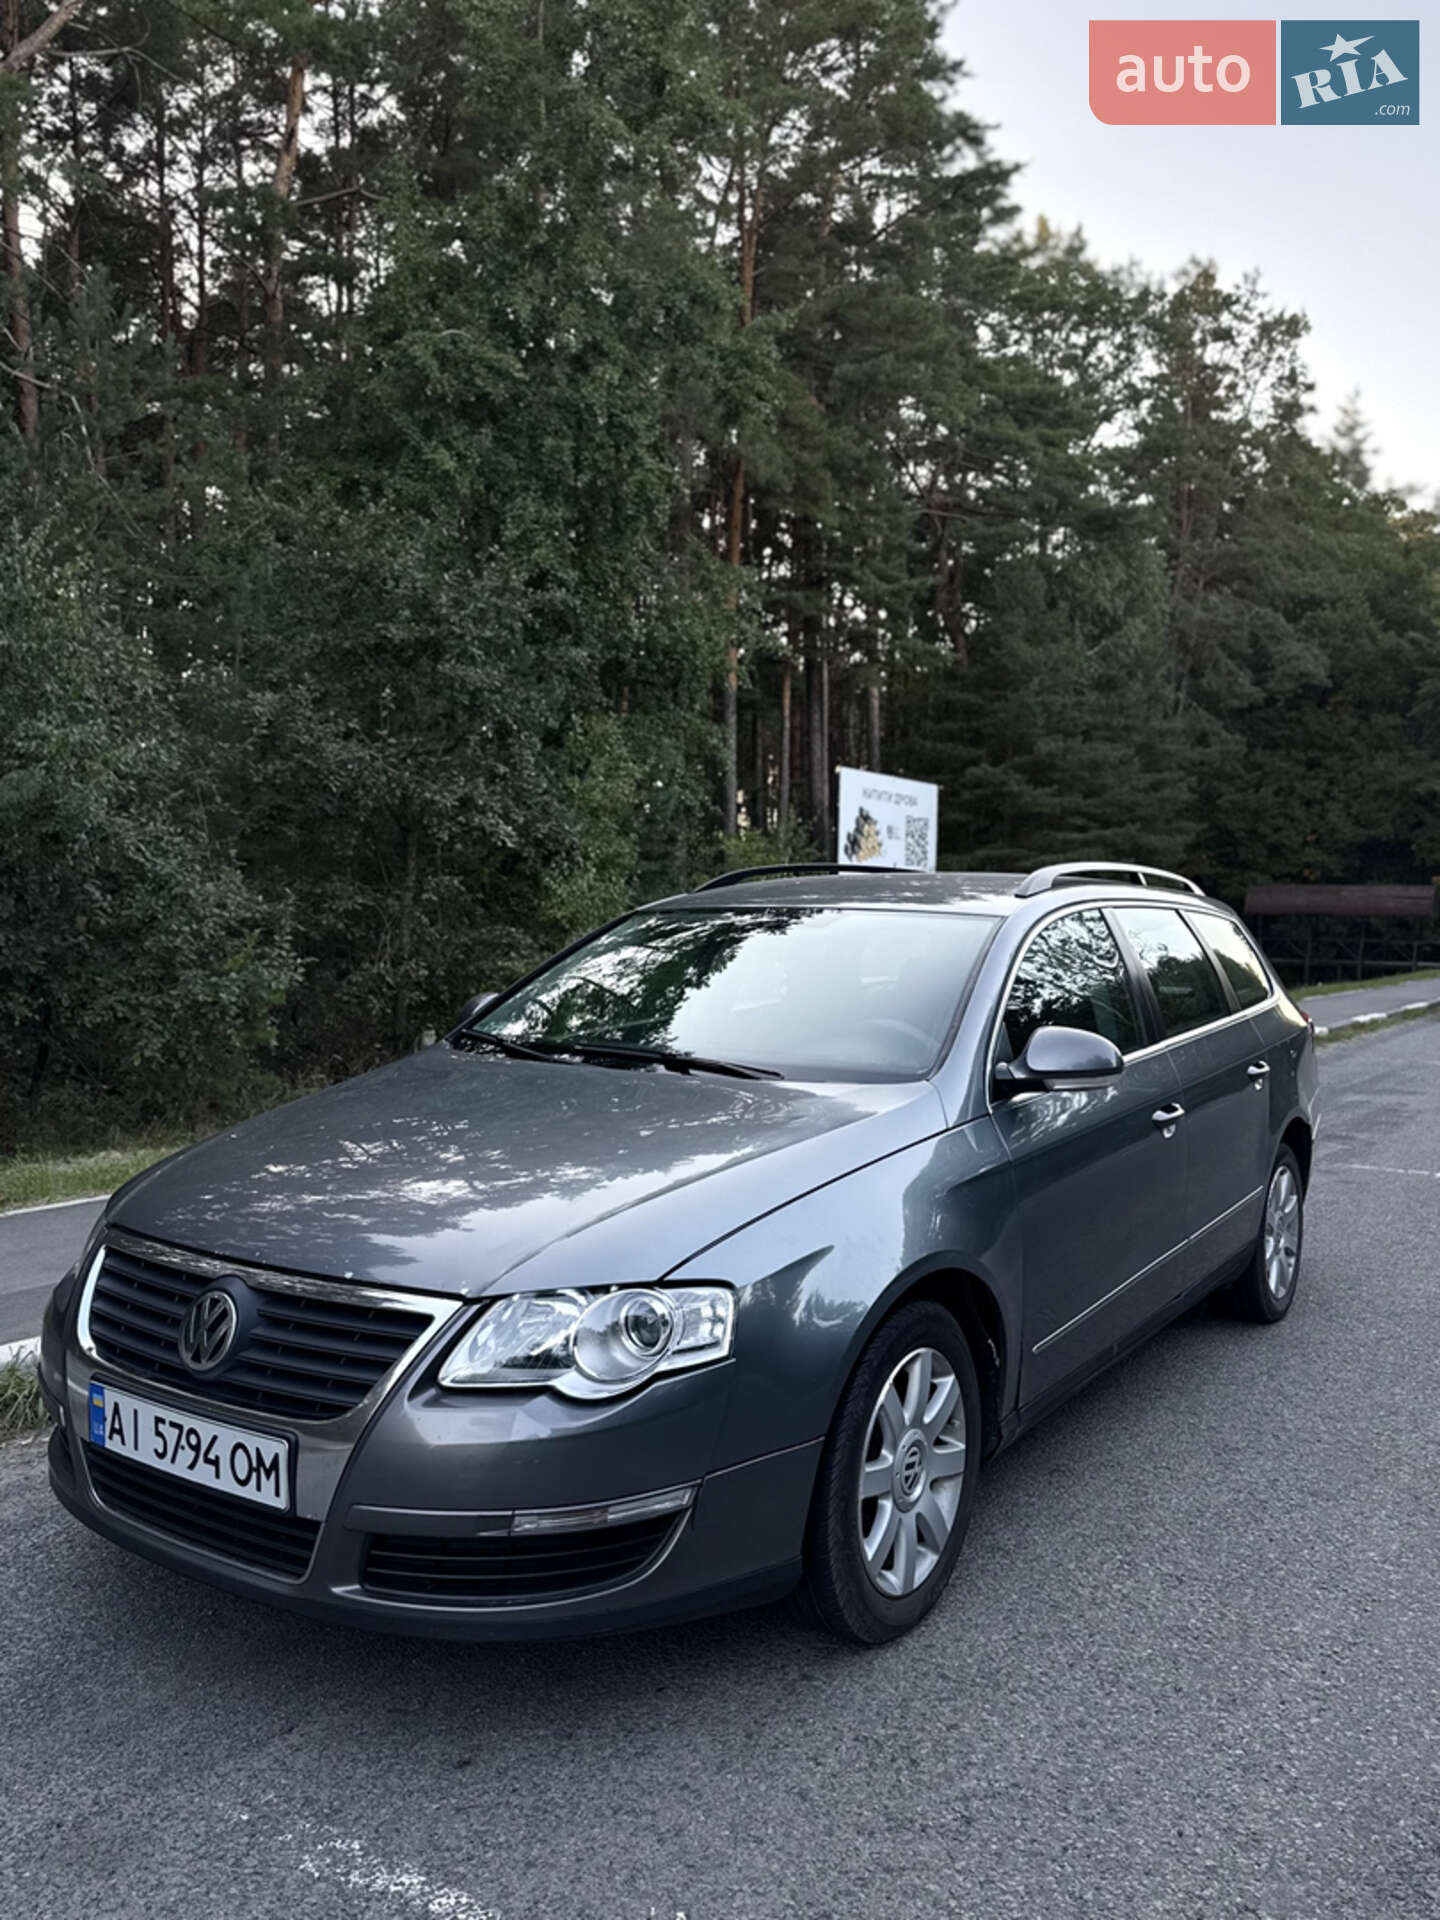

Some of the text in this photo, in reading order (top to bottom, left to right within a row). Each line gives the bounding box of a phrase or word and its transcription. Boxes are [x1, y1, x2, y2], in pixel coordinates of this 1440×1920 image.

[108, 1401, 281, 1498] AI 5794 OM
